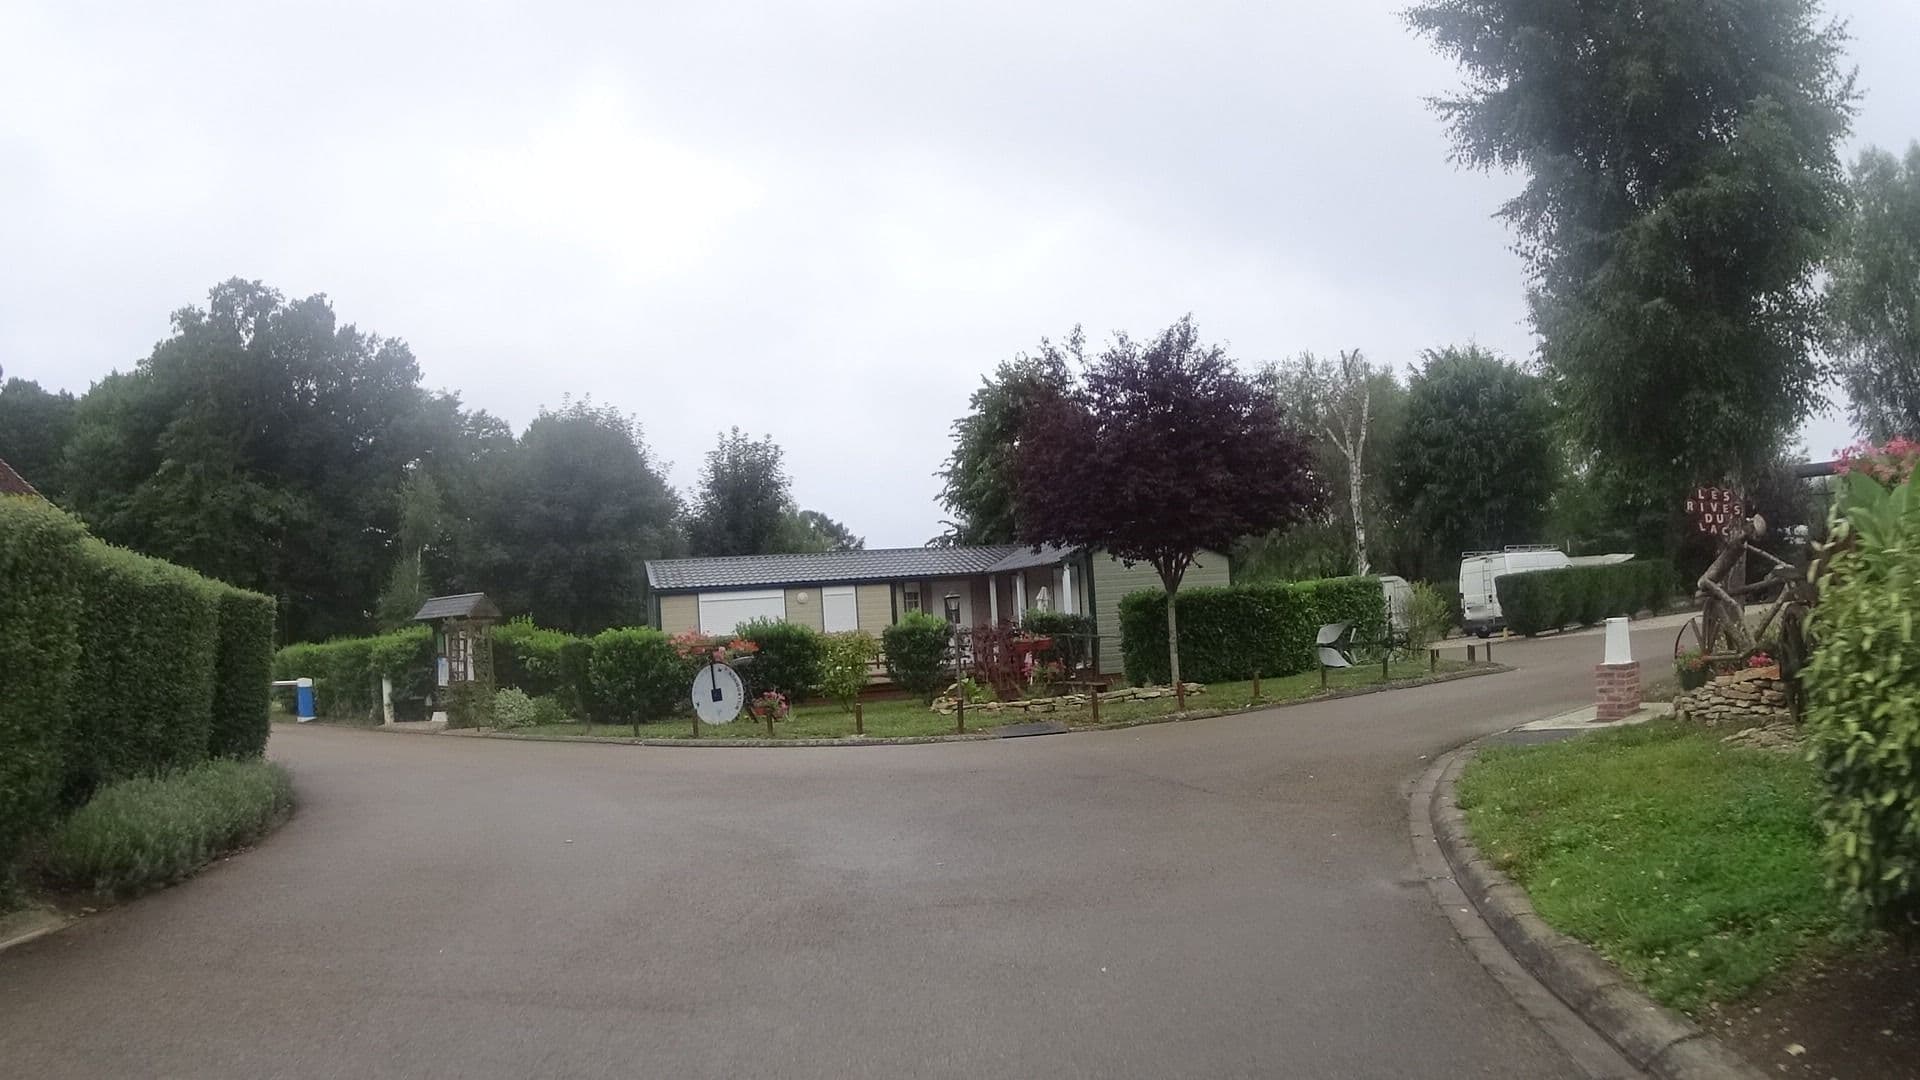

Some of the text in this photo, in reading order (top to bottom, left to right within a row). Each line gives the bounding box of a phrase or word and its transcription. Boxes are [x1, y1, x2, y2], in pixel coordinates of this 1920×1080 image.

[1698, 489, 1730, 501] LES
[1686, 501, 1740, 515] RIVES
[1705, 513, 1724, 524] DU
[1698, 523, 1729, 536] LAC
